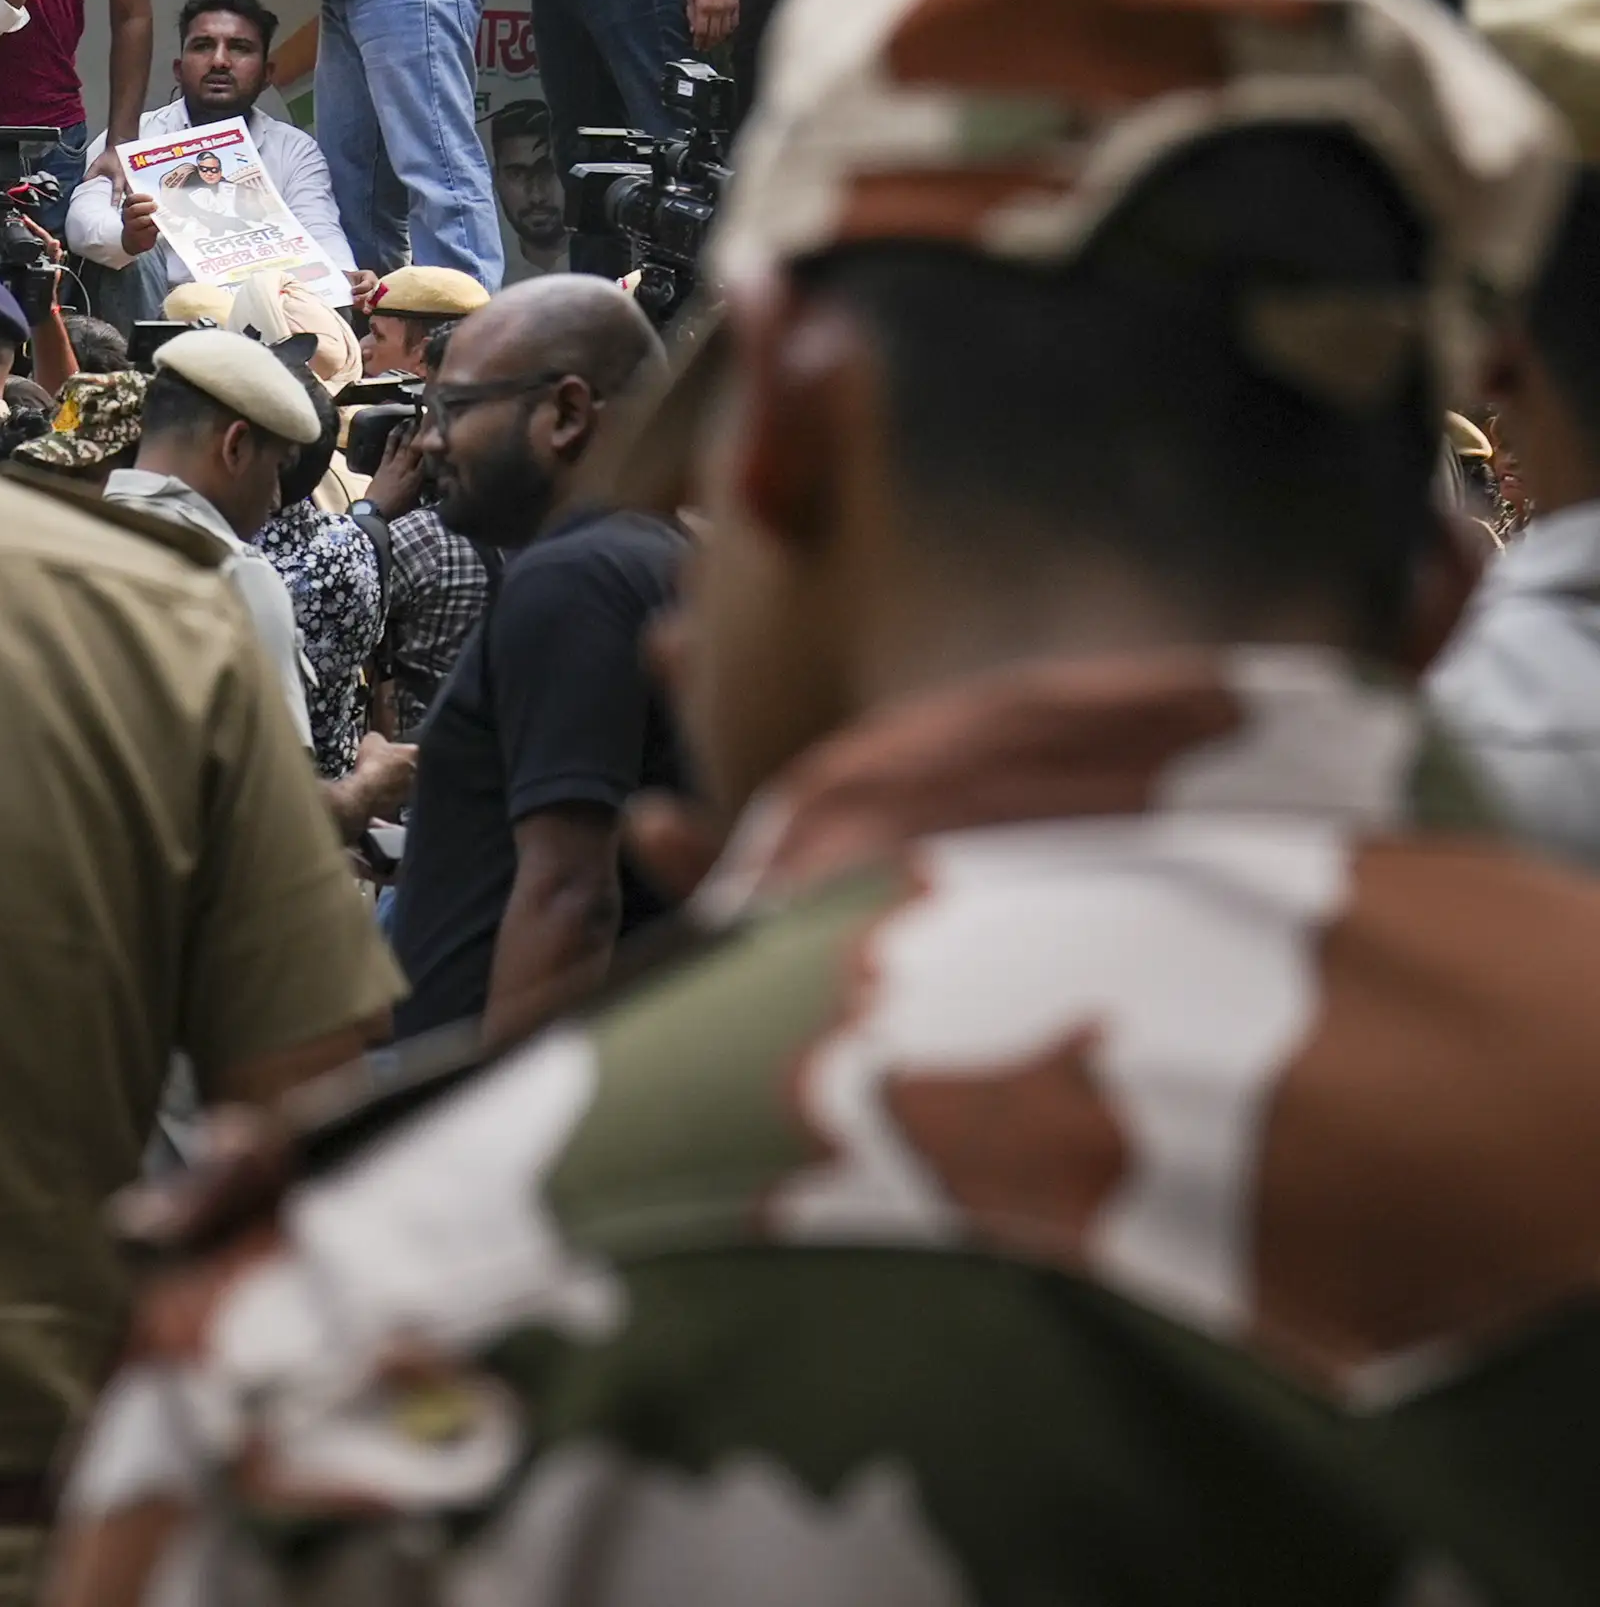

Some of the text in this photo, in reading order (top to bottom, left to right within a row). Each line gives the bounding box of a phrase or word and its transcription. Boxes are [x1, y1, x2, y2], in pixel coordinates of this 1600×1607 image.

[134, 155, 146, 168] 14
[194, 223, 285, 257] दिनदहाड़े
[197, 248, 255, 275] लोकतंत्र
[256, 244, 276, 259] की
[279, 236, 310, 256] लूट
